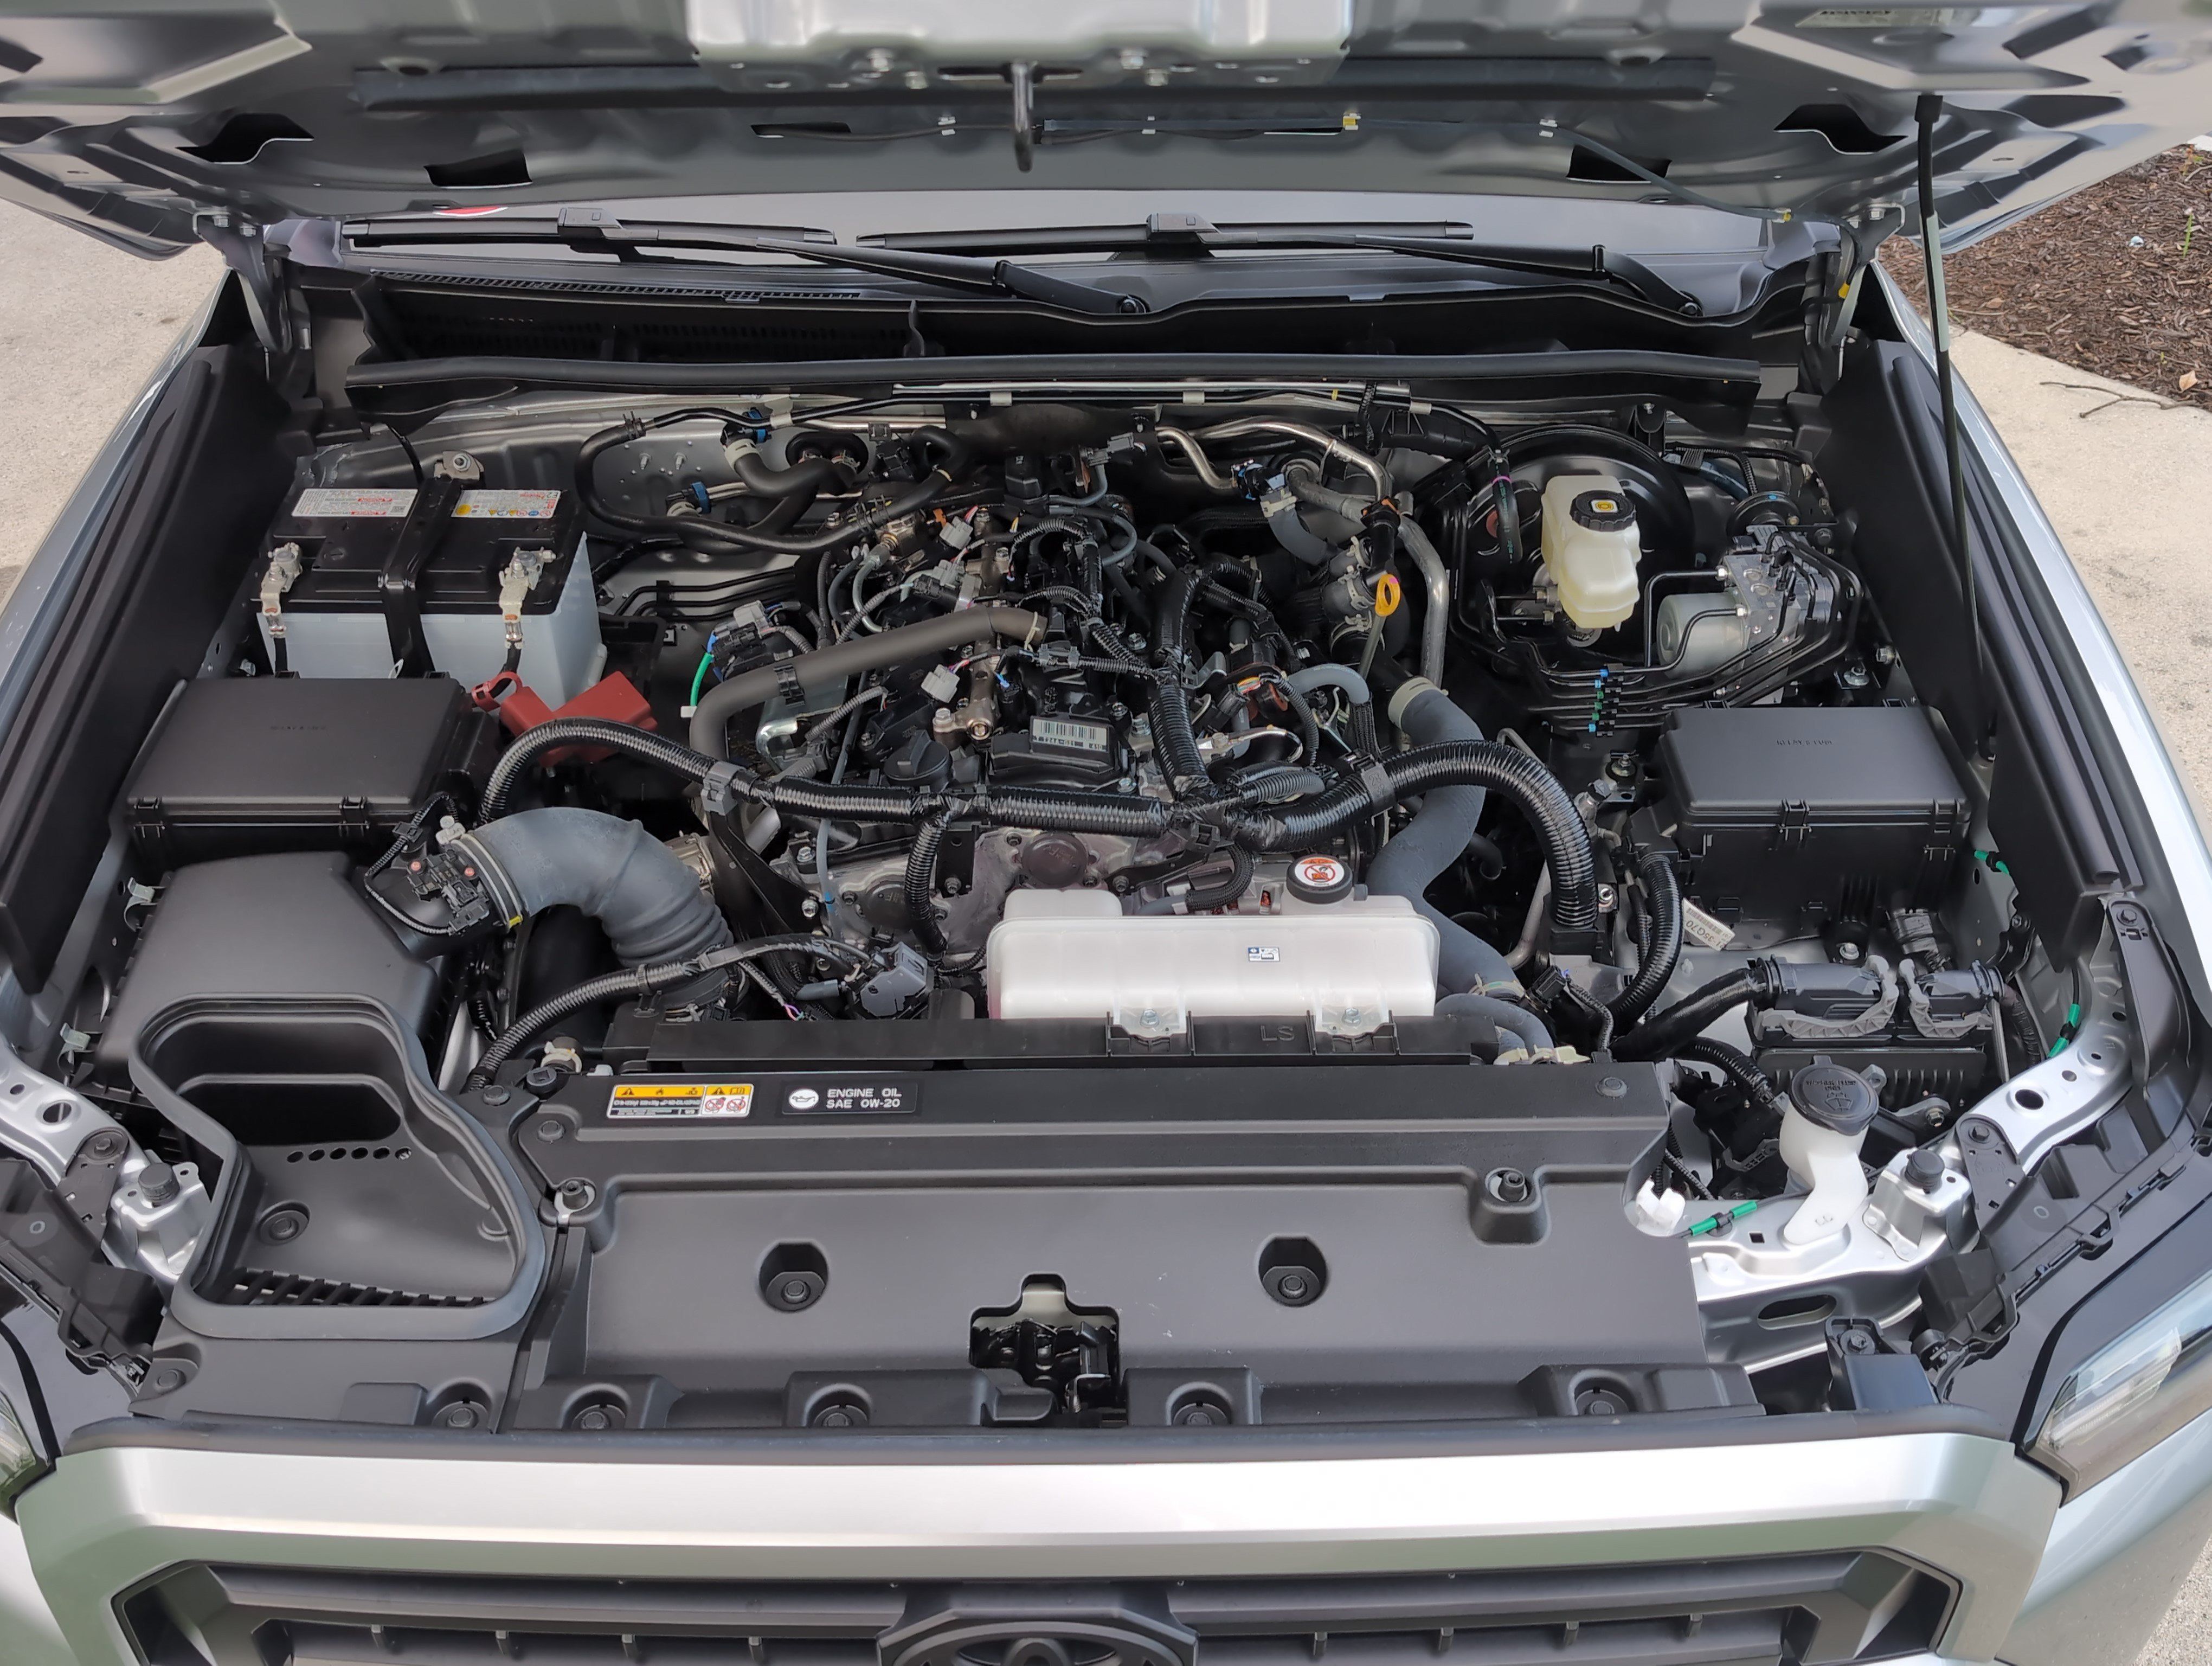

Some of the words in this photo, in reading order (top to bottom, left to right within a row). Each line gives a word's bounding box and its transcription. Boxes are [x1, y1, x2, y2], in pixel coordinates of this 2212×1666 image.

[1261, 1024, 1295, 1042] LS
[827, 1088, 874, 1098] ENGINE
[882, 1088, 902, 1098] OIL
[826, 1099, 853, 1109] SAE
[860, 1098, 901, 1108] 0W-20
